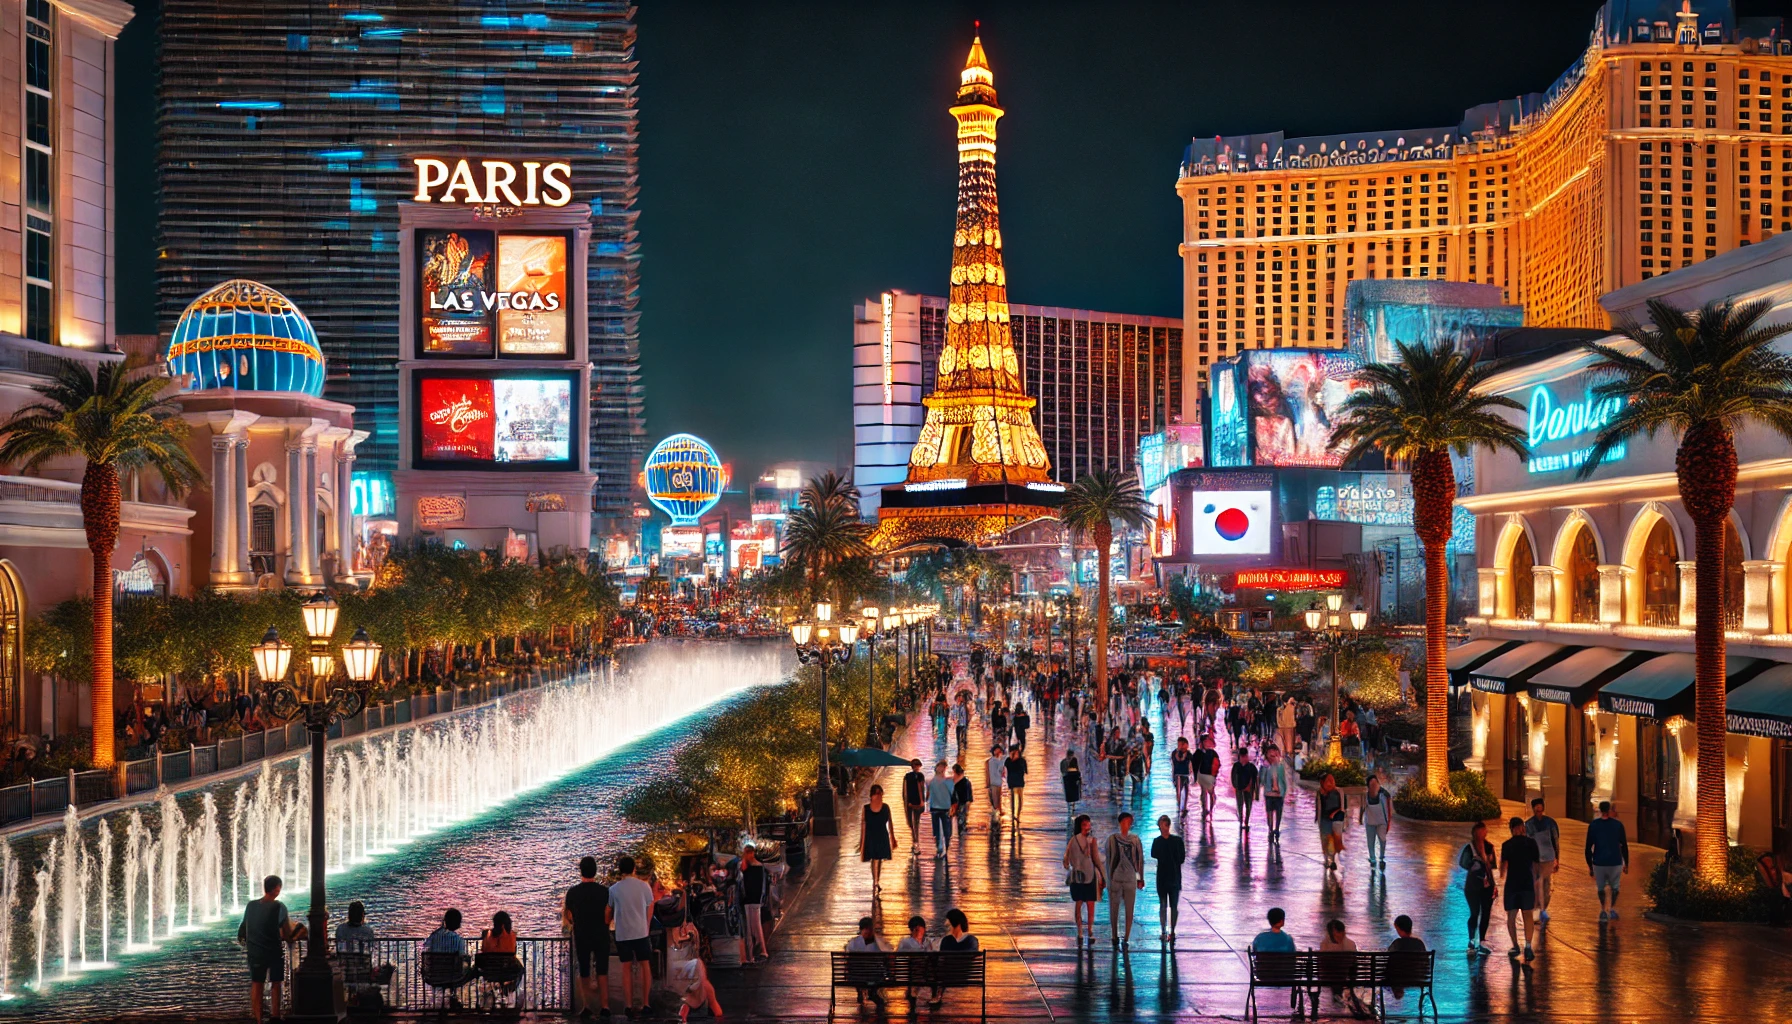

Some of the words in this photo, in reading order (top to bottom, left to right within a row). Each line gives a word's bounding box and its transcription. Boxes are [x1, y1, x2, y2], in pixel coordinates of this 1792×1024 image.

[413, 158, 573, 208] PARIS
[430, 291, 474, 311] LAS
[480, 291, 560, 312] VEGAS
